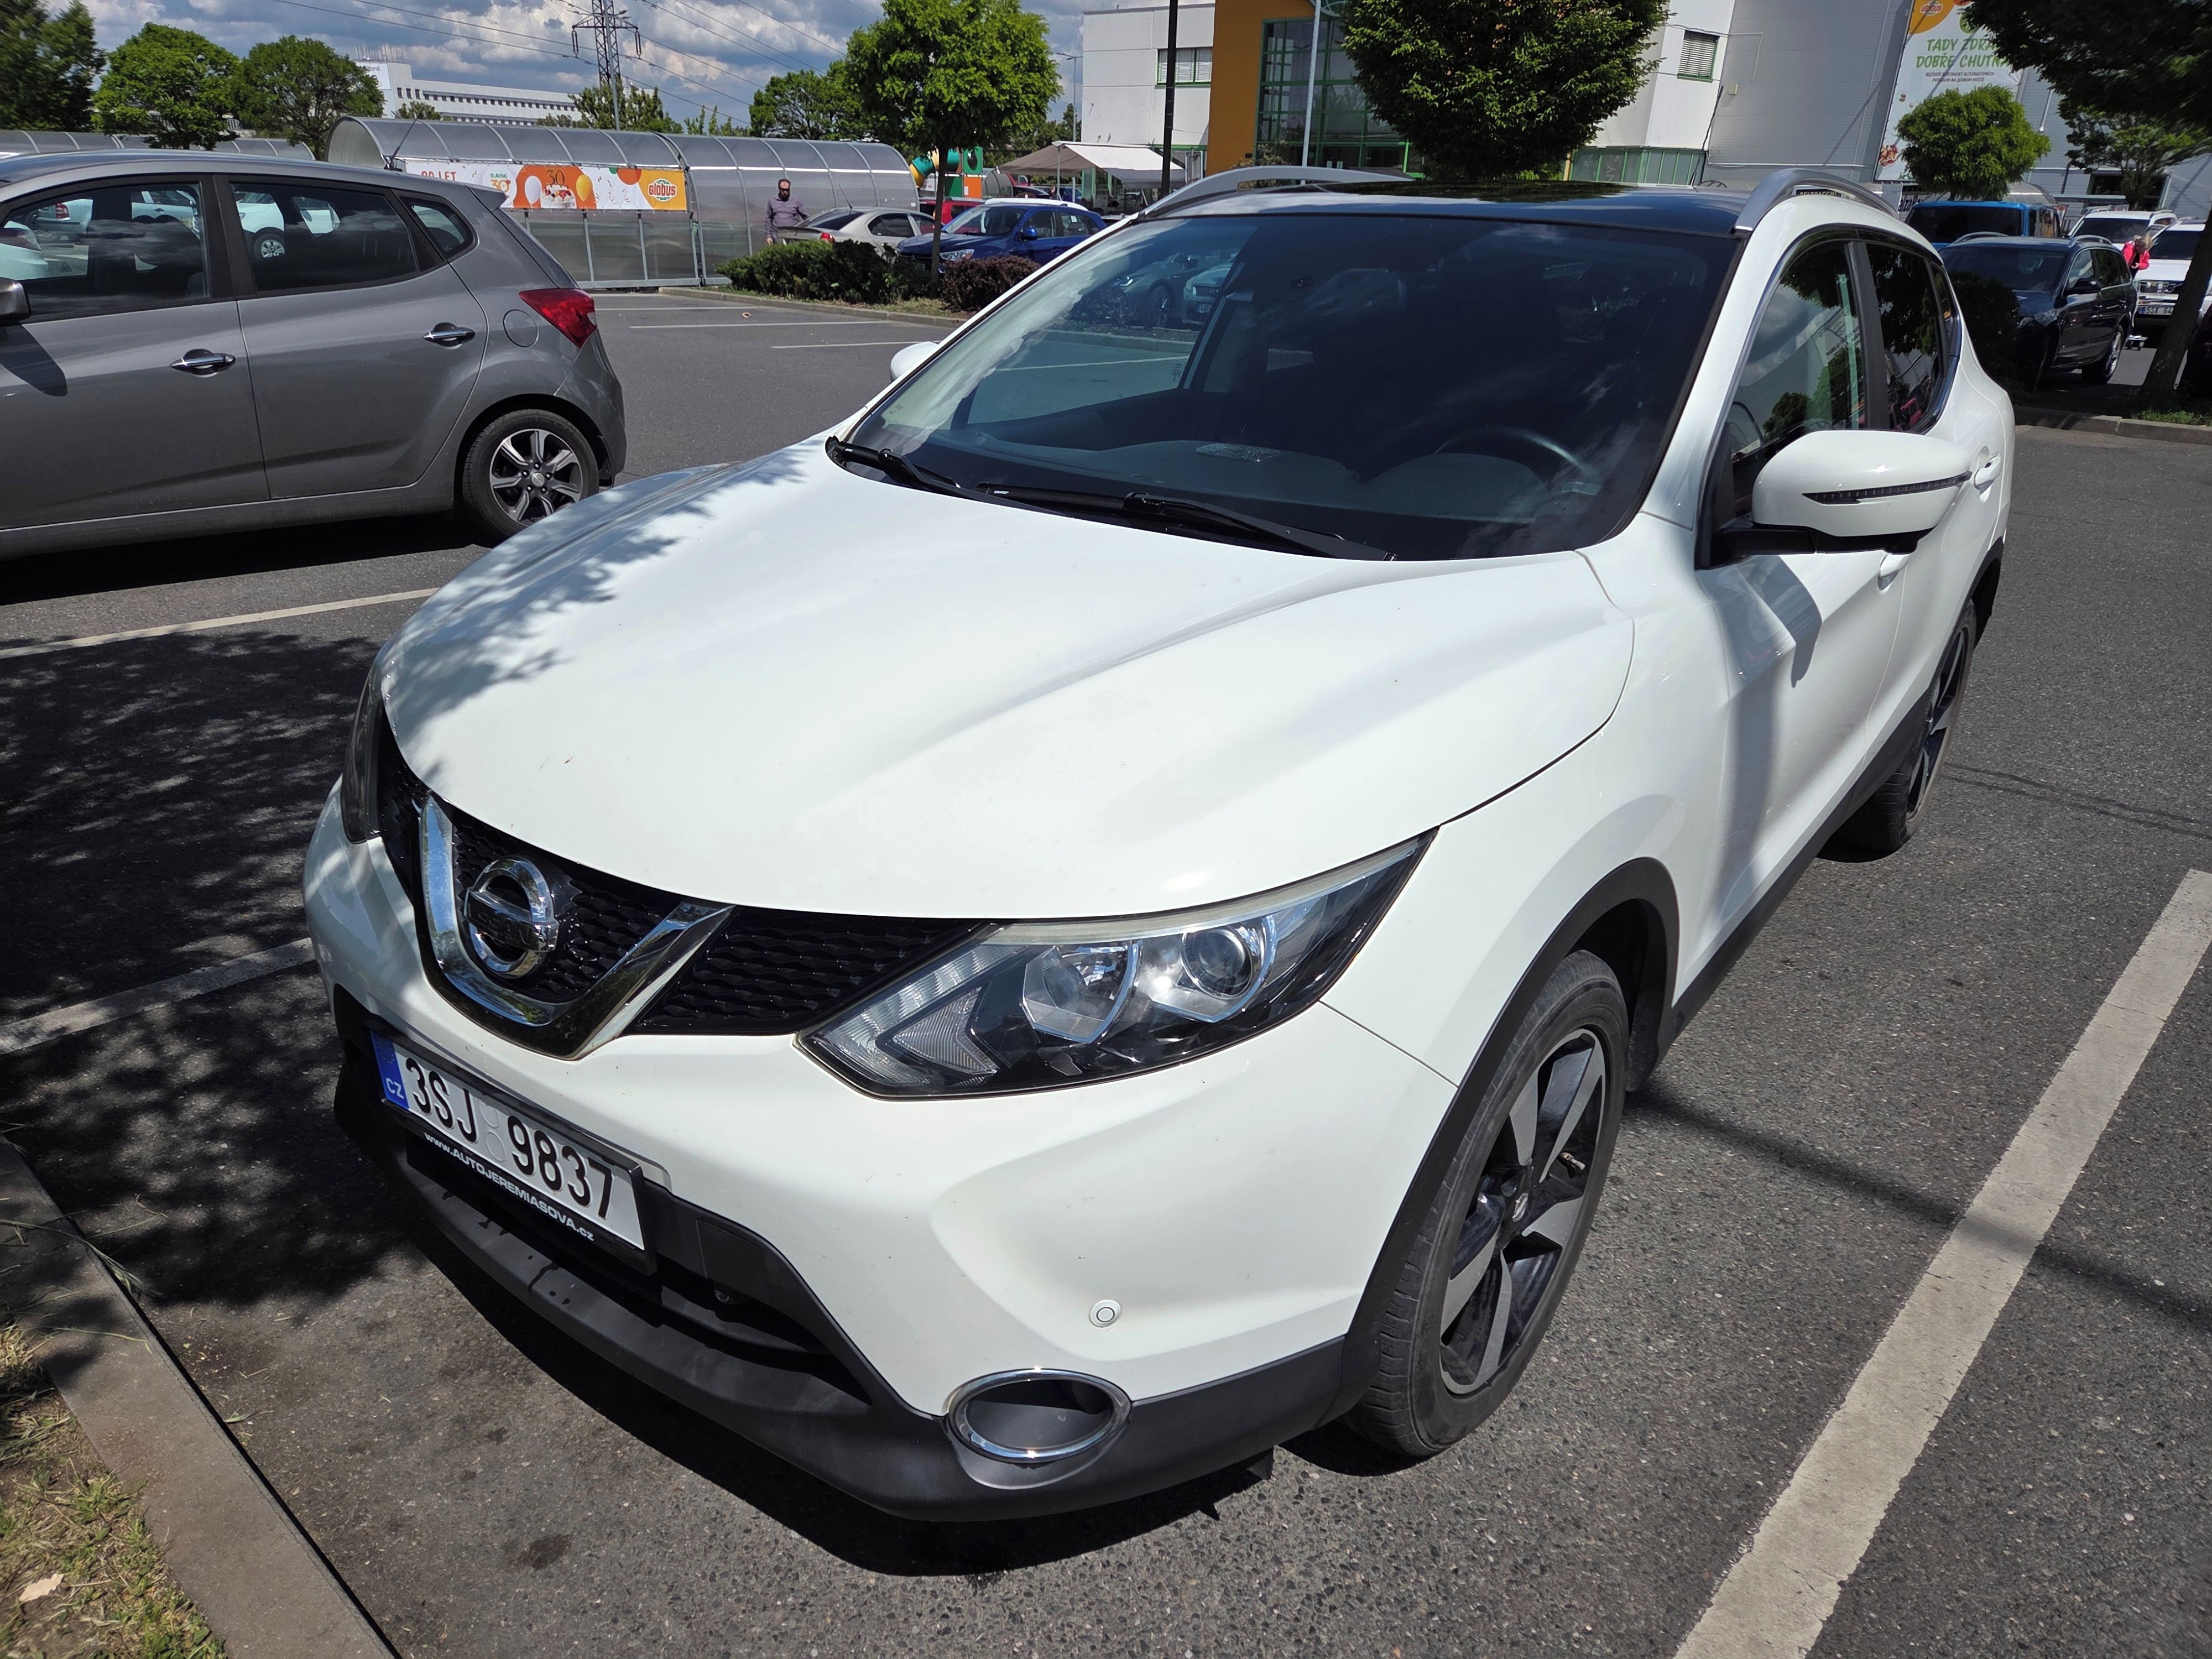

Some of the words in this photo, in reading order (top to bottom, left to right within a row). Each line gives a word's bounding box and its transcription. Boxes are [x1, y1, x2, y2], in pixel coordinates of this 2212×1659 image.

[1927, 38, 1958, 51] TADY
[1963, 38, 1997, 50] ZDRA
[1916, 52, 1957, 68] DOBŘE
[491, 179, 509, 192] 30
[546, 169, 565, 187] 30
[385, 1077, 405, 1099] CZ
[405, 1057, 477, 1144] 3SJ
[507, 1114, 612, 1219] 9837
[424, 1131, 594, 1241] www.AUTOJEREMIASOVA.cz
